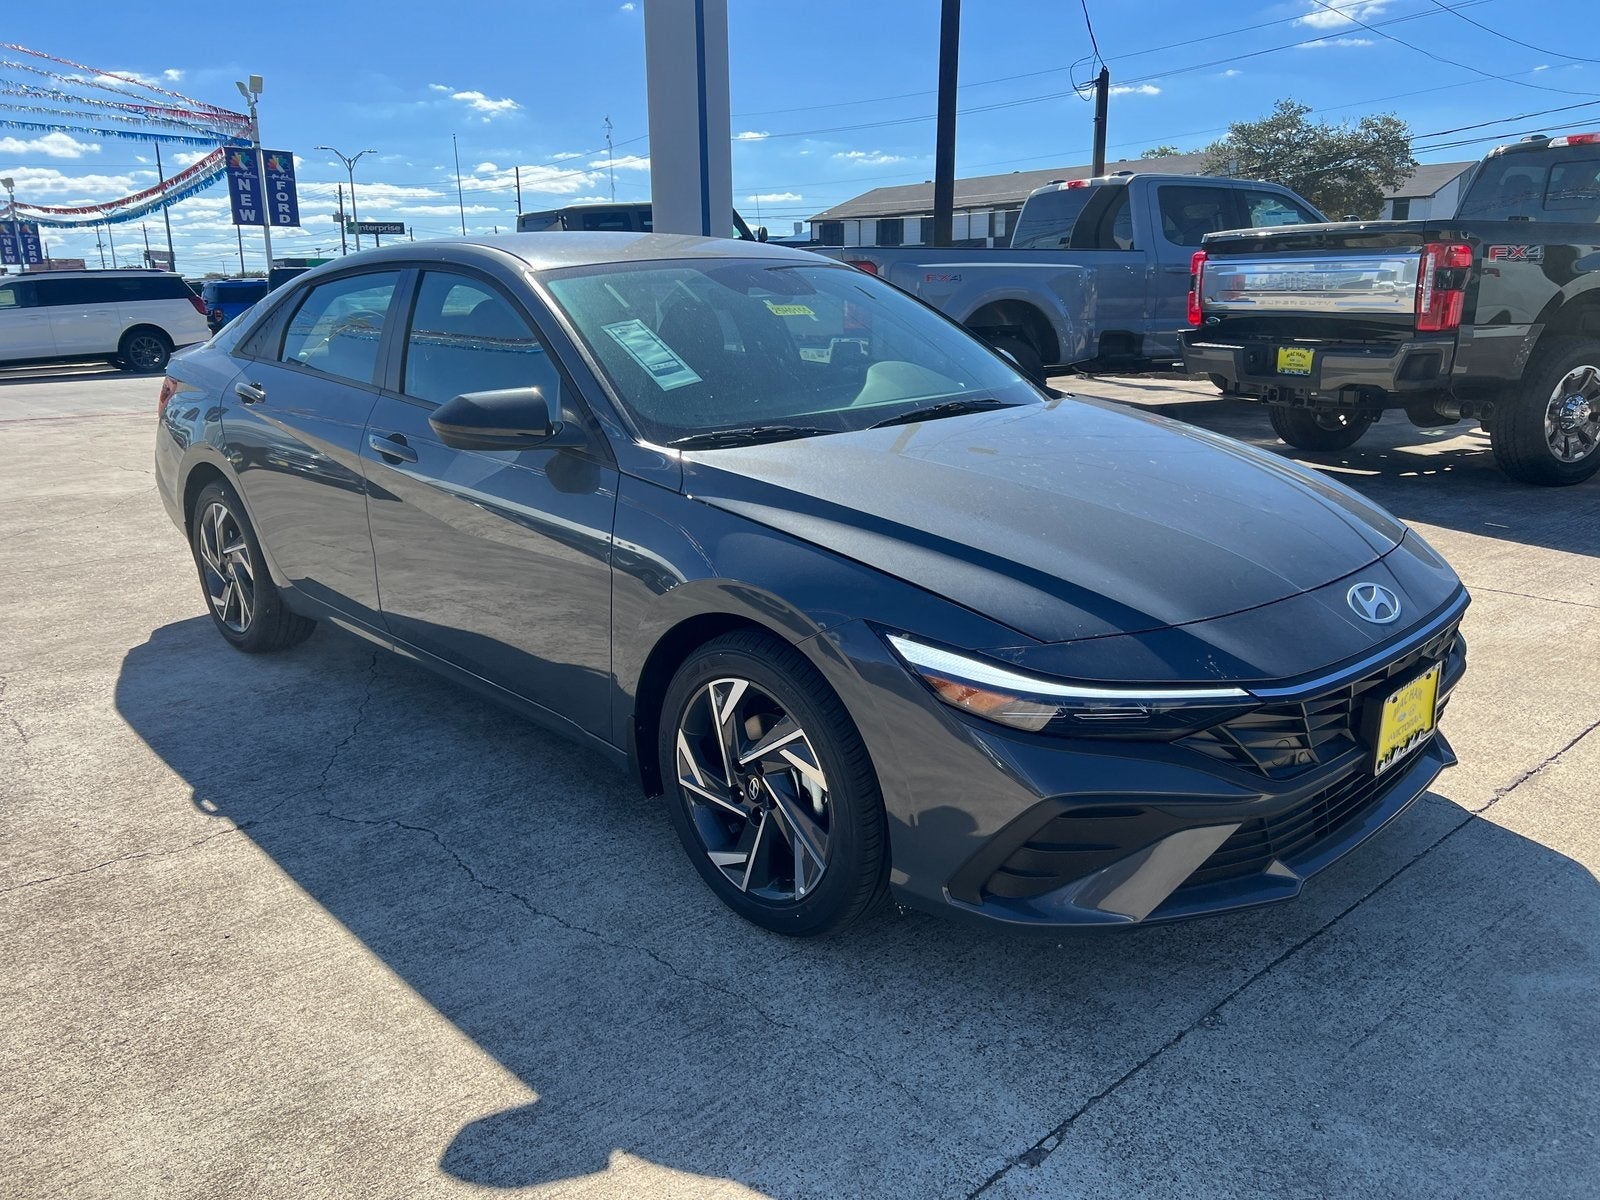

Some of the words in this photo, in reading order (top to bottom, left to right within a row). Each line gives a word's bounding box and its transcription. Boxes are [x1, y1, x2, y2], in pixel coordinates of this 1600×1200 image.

[237, 178, 256, 222] NEW
[275, 181, 291, 223] FORD
[356, 224, 401, 233] nterprise
[3, 238, 15, 263] NEW
[27, 238, 38, 263] FORD
[1488, 244, 1544, 263] FX4
[924, 273, 963, 283] FX4
